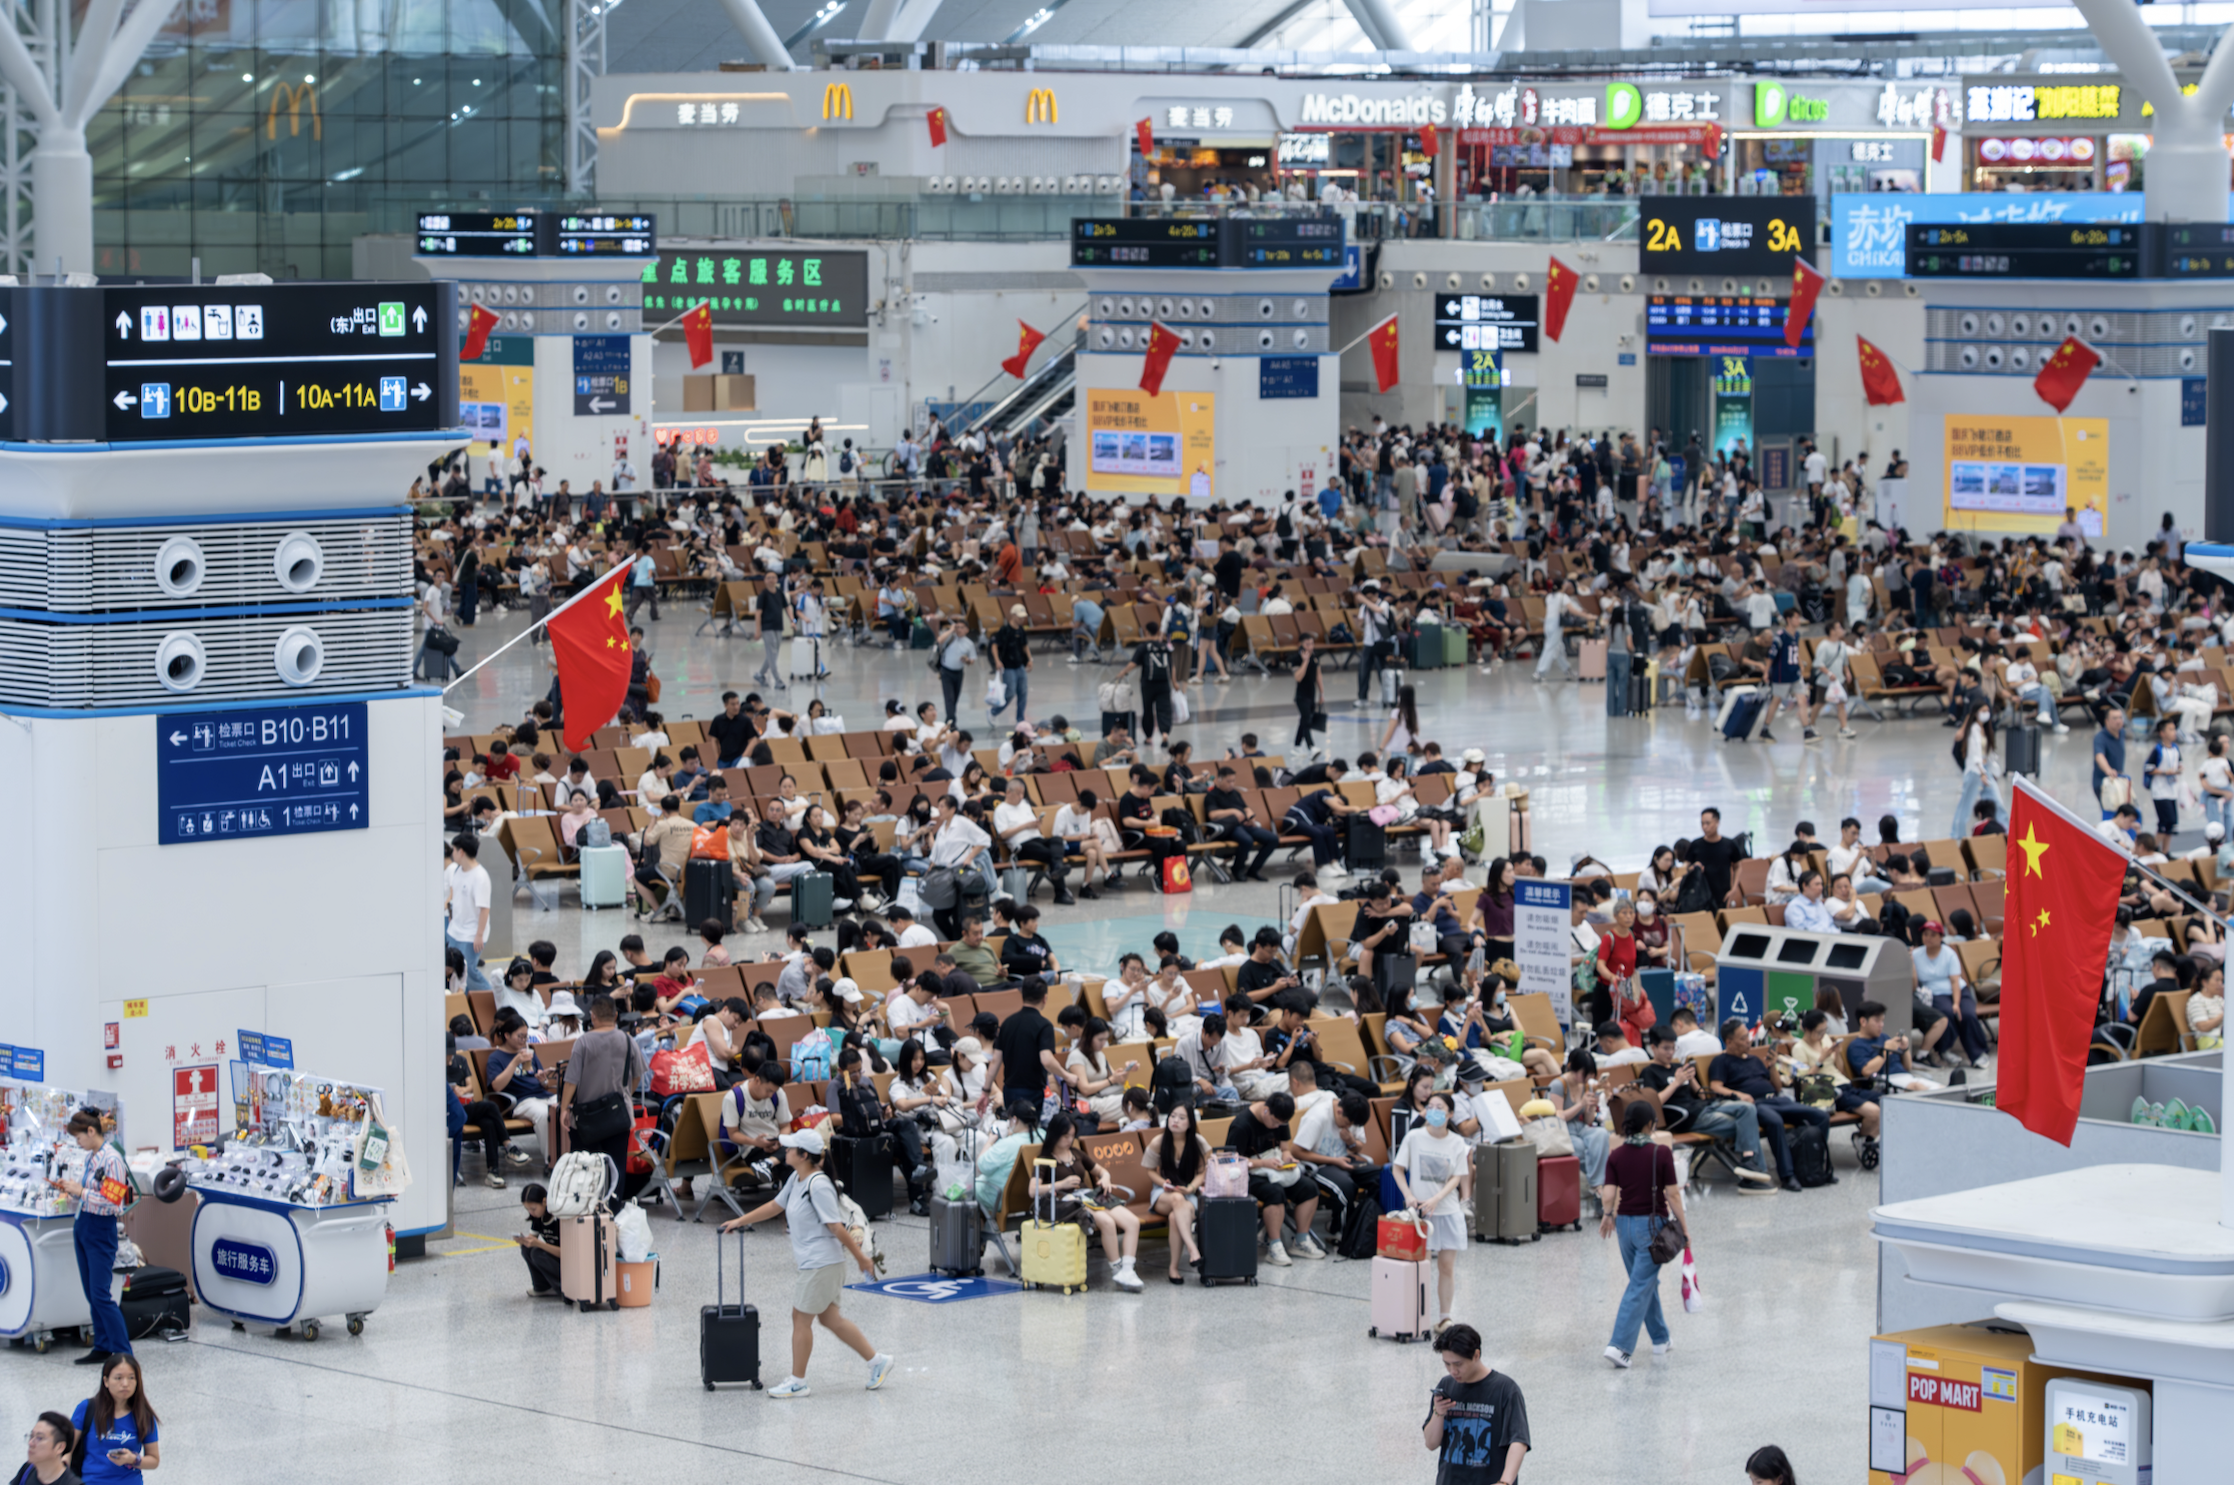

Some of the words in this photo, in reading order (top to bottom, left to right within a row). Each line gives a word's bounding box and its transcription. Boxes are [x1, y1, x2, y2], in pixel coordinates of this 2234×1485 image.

[678, 103, 740, 125] 麦当劳
[1168, 106, 1234, 128] 麦当劳
[1302, 93, 1447, 125] McDonald's
[1542, 97, 1597, 125] 牛肉面
[1646, 91, 1721, 121] 德克士
[1789, 94, 1829, 121] dicos
[1646, 218, 1682, 252] 2A
[1766, 218, 1802, 252] 3A
[353, 307, 377, 325] 出口
[362, 324, 377, 335] Exit
[1472, 354, 1495, 370] 2A
[1723, 361, 1746, 377] 3A
[175, 384, 262, 414] 10B-11B
[295, 382, 377, 412] 10A-11A
[218, 721, 255, 738] 检票口
[218, 739, 236, 749] Ticket
[237, 737, 257, 748] Check
[257, 763, 288, 792] A1
[292, 762, 315, 778] 出口
[303, 778, 315, 788] Exit
[282, 806, 291, 827] 1
[294, 804, 322, 819] 检票口
[165, 1039, 226, 1061] 消火栓
[216, 1247, 271, 1278] 旅行服务车
[1910, 1376, 1937, 1401] POP
[1940, 1381, 1979, 1409] MART
[1466, 1401, 1496, 1415] JACKSON
[2065, 1406, 2119, 1429] 手机充电站
